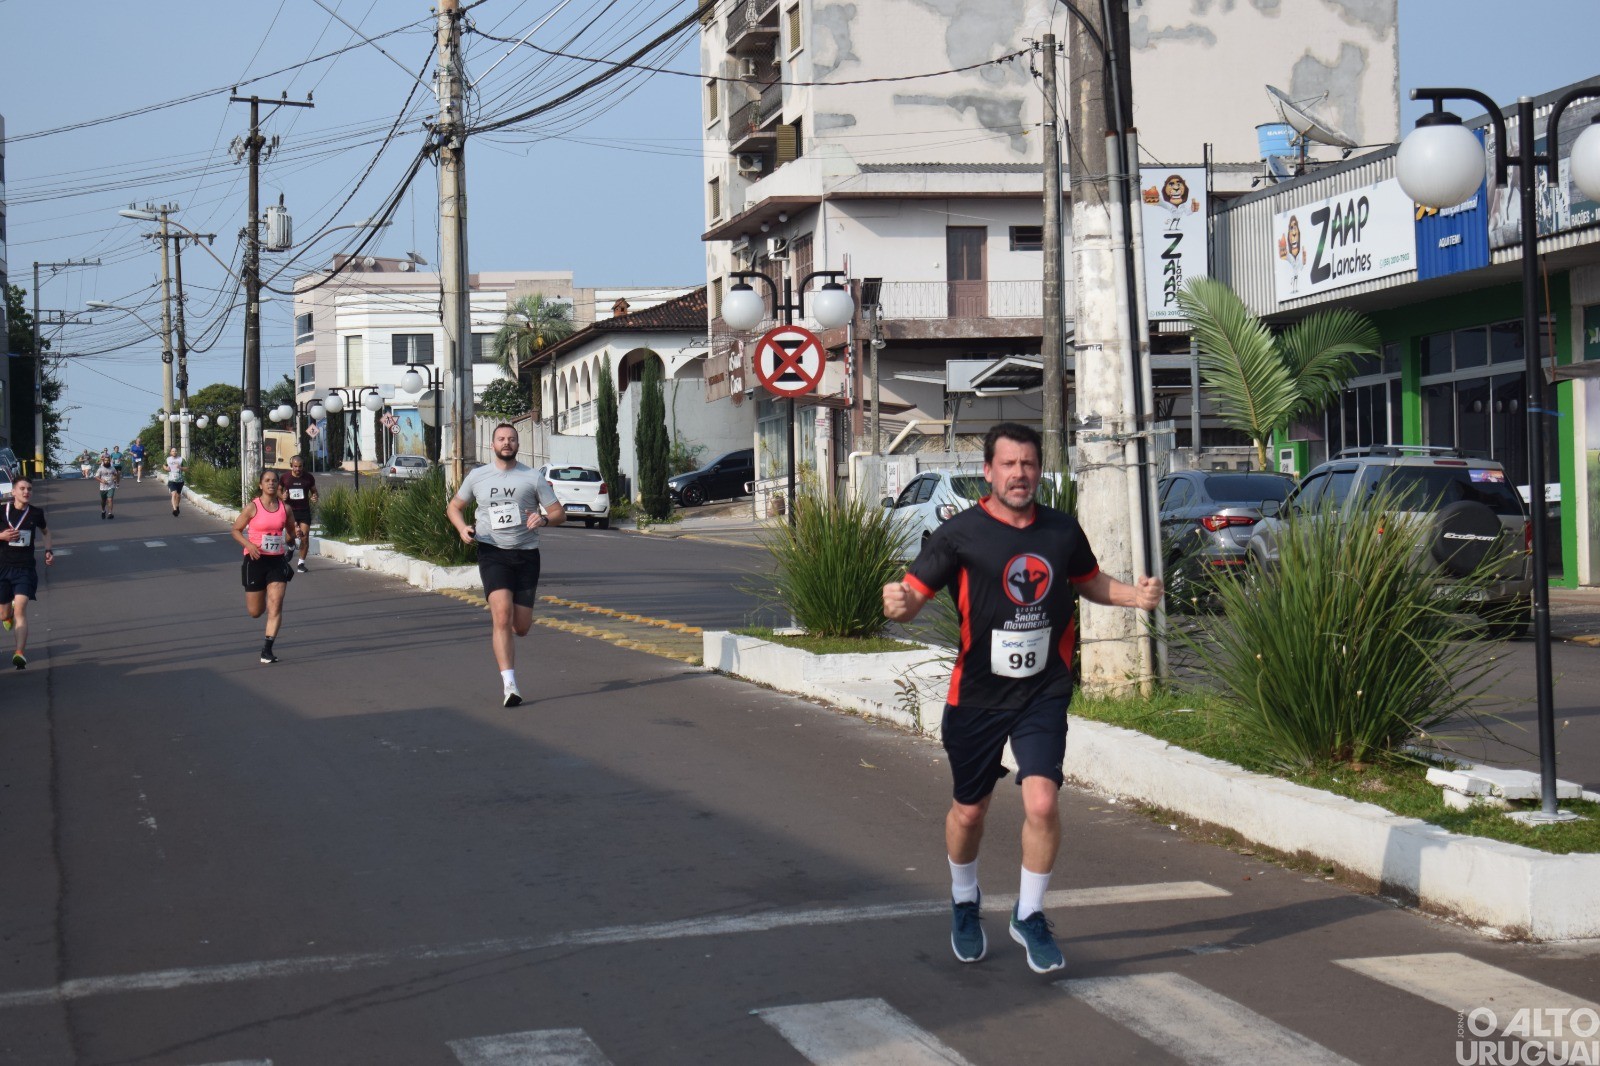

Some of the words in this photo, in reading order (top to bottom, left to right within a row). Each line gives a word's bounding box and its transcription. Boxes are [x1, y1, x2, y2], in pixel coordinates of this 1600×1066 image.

[1571, 209, 1590, 227] RAÇÕES
[1310, 195, 1369, 285] ZAAP
[1161, 233, 1184, 307] ZAAP
[1332, 248, 1372, 280] Lanches
[498, 514, 513, 524] 42
[1008, 651, 1036, 670] 98
